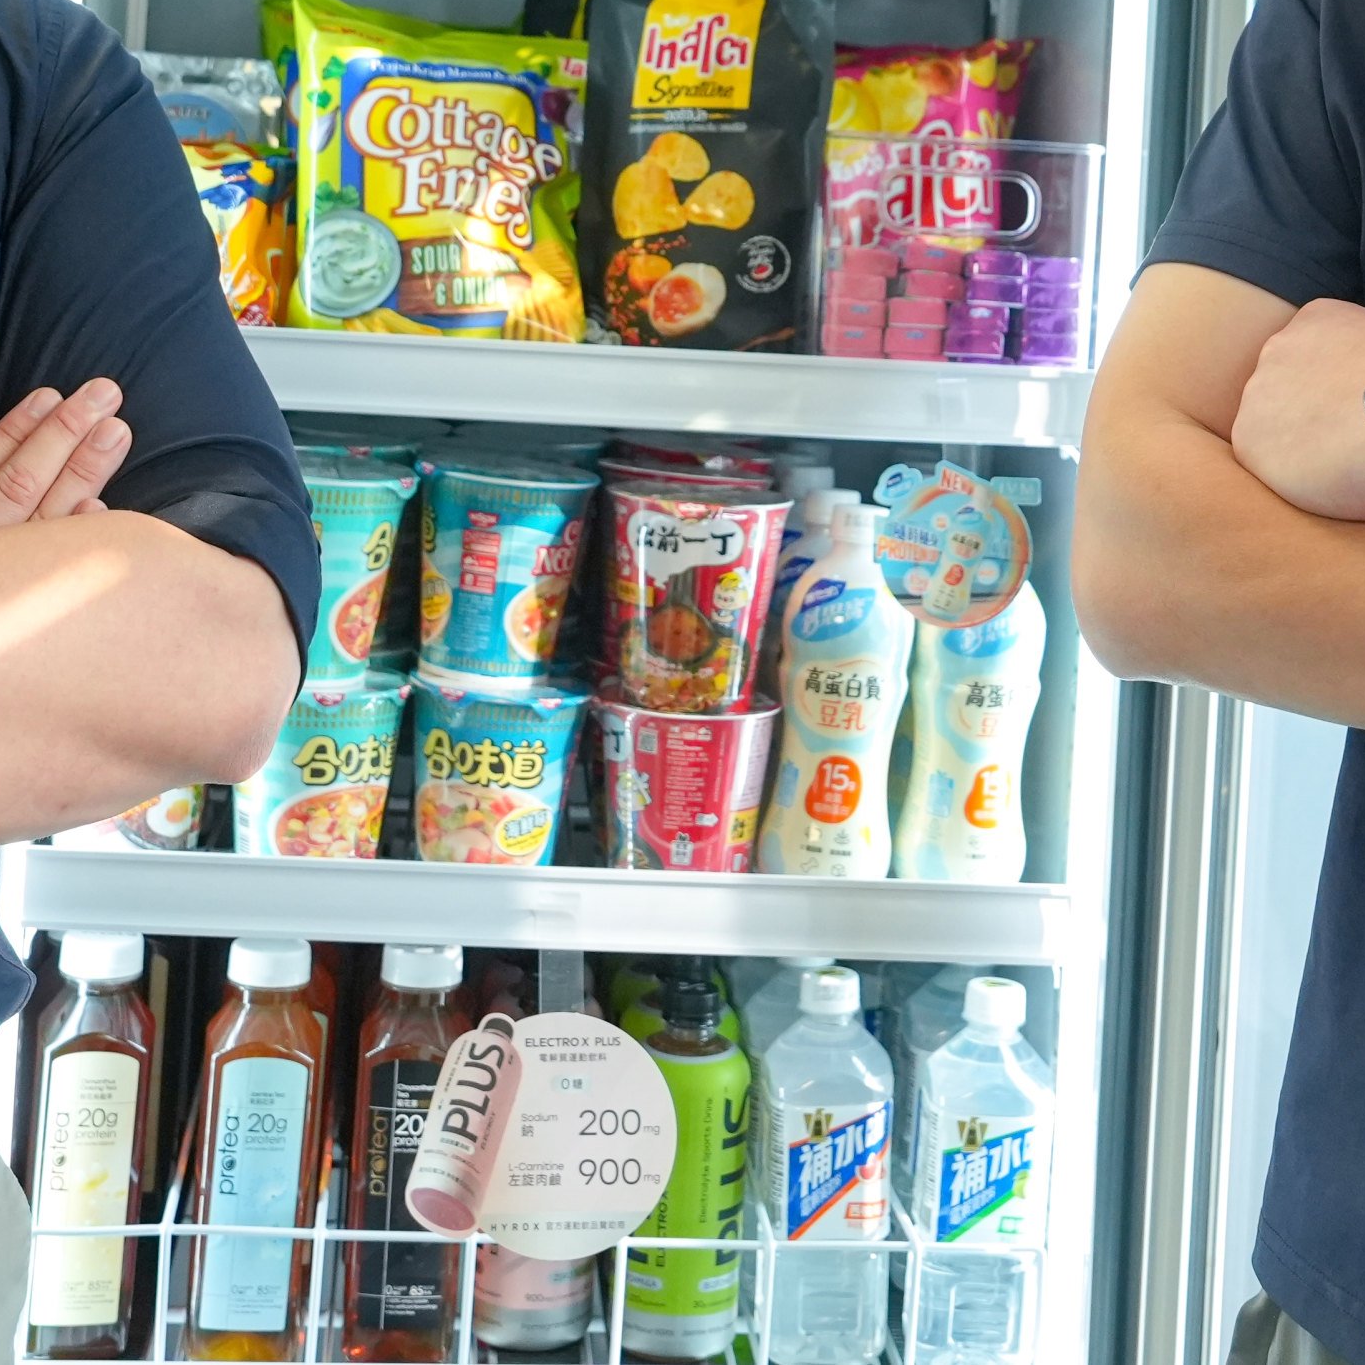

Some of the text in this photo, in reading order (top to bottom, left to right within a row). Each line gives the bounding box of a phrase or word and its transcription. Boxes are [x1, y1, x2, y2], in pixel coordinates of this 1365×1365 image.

[347, 87, 562, 185] Cottage
[393, 150, 533, 247] Fries
[411, 242, 462, 275] SOUR
[818, 699, 867, 731] 豆乳
[424, 728, 547, 789] 合味道
[525, 1037, 621, 1047] ELECTRO X PLUS
[441, 1042, 505, 1144] PLUS
[561, 1078, 570, 1089] 0
[78, 1108, 118, 1128] 20g
[247, 1113, 288, 1133] 20g
[395, 1114, 426, 1136] 20
[521, 1112, 558, 1122] Sodium
[578, 1109, 660, 1135] 200 mg
[75, 1129, 117, 1140] protein
[245, 1135, 287, 1145] protein
[394, 1137, 422, 1147] prot
[218, 1115, 239, 1195] protea
[508, 1162, 564, 1171] L-Carnitine
[578, 1158, 661, 1185] 900 mg
[490, 1222, 540, 1231] HYROX
